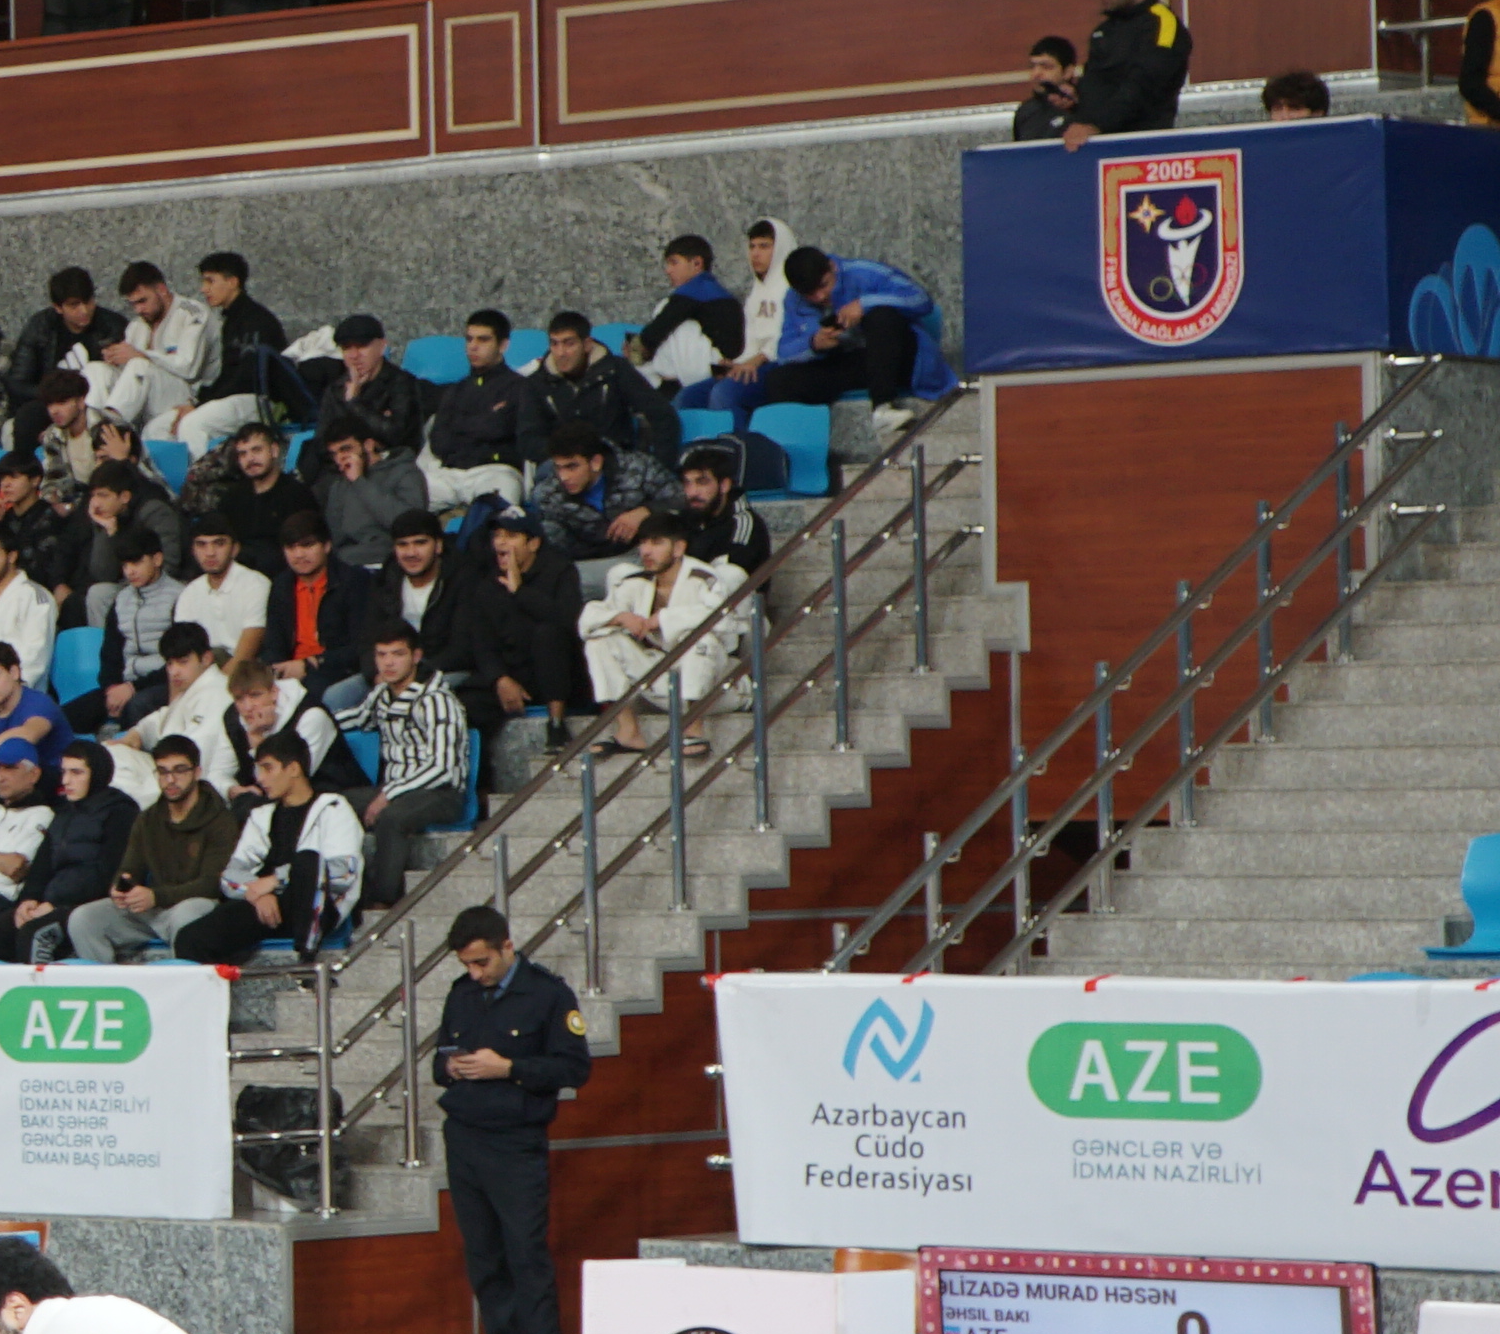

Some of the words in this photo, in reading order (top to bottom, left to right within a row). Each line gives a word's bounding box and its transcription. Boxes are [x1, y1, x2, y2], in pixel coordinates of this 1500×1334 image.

[1146, 159, 1196, 182] 2005
[21, 999, 125, 1051] AZE
[1068, 1039, 1222, 1105] AZE
[19, 1079, 98, 1095] GƏNCLƏR
[102, 1079, 126, 1095] VƏ
[18, 1094, 74, 1113] İDMAN
[77, 1095, 151, 1114] NAZİRLİYİ
[20, 1115, 53, 1130] BAKI
[56, 1114, 109, 1133] ŞƏHƏR
[811, 1102, 967, 1133] Azərbaycan
[21, 1132, 92, 1149] GƏNCLƏR
[95, 1133, 118, 1149] VƏ
[854, 1134, 924, 1159] Cüdo
[1072, 1139, 1184, 1160] GƏNCLƏR
[1190, 1142, 1223, 1160] VƏ
[21, 1149, 70, 1166] İDMAN
[804, 1163, 973, 1198] Federasiyası
[1072, 1158, 1146, 1181] İDMAN
[1152, 1160, 1263, 1186] NAZİRLİYİ
[1026, 1282, 1099, 1301] MURAD
[1104, 1285, 1177, 1305] HƏSƏN
[994, 1308, 1030, 1323] BAKI
